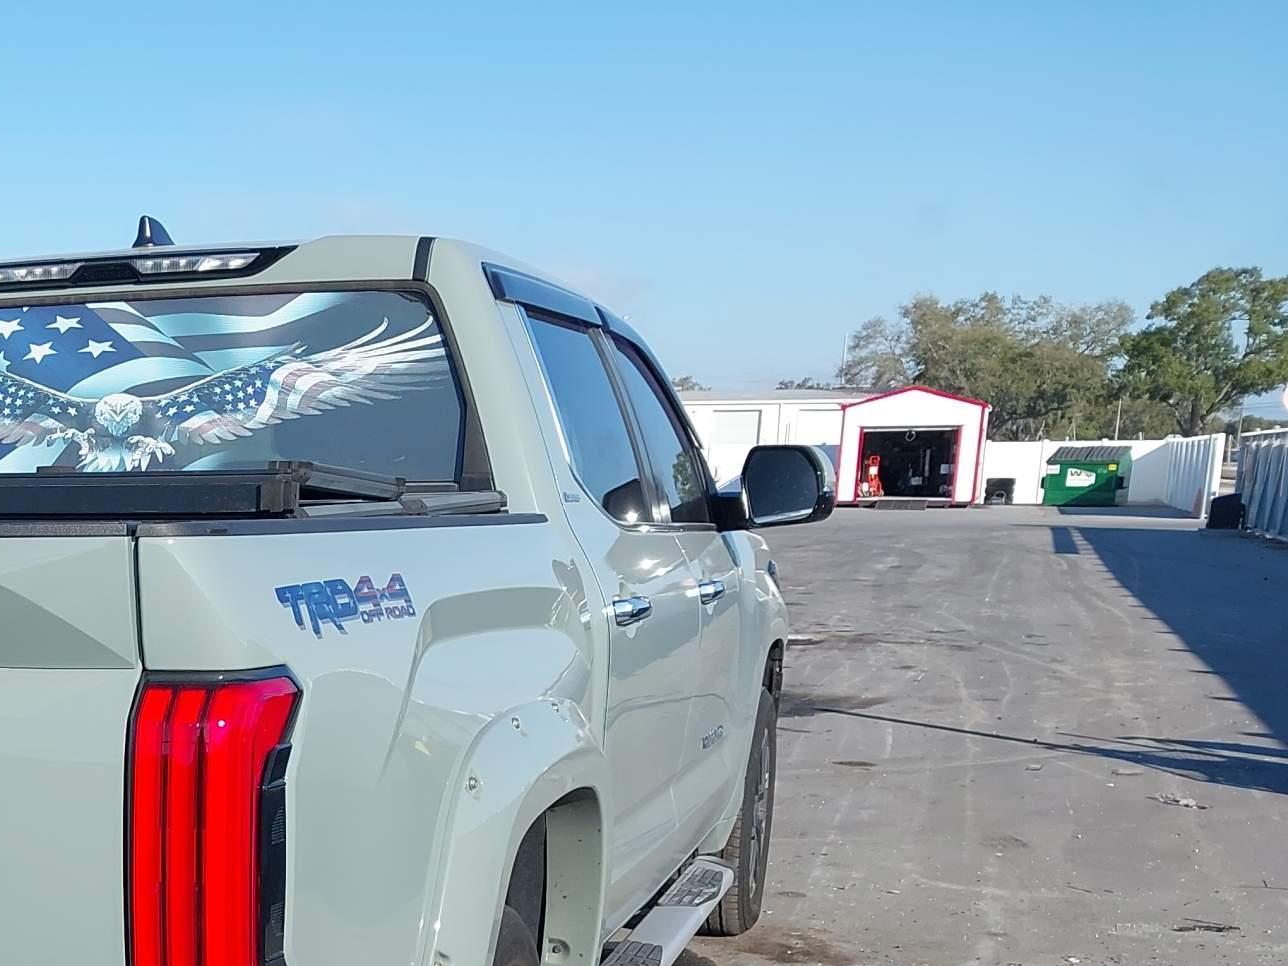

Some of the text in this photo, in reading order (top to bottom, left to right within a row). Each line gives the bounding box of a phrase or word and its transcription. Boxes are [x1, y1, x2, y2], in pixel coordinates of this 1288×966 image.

[274, 578, 360, 639] TRD
[360, 604, 416, 624] OFF ROAD
